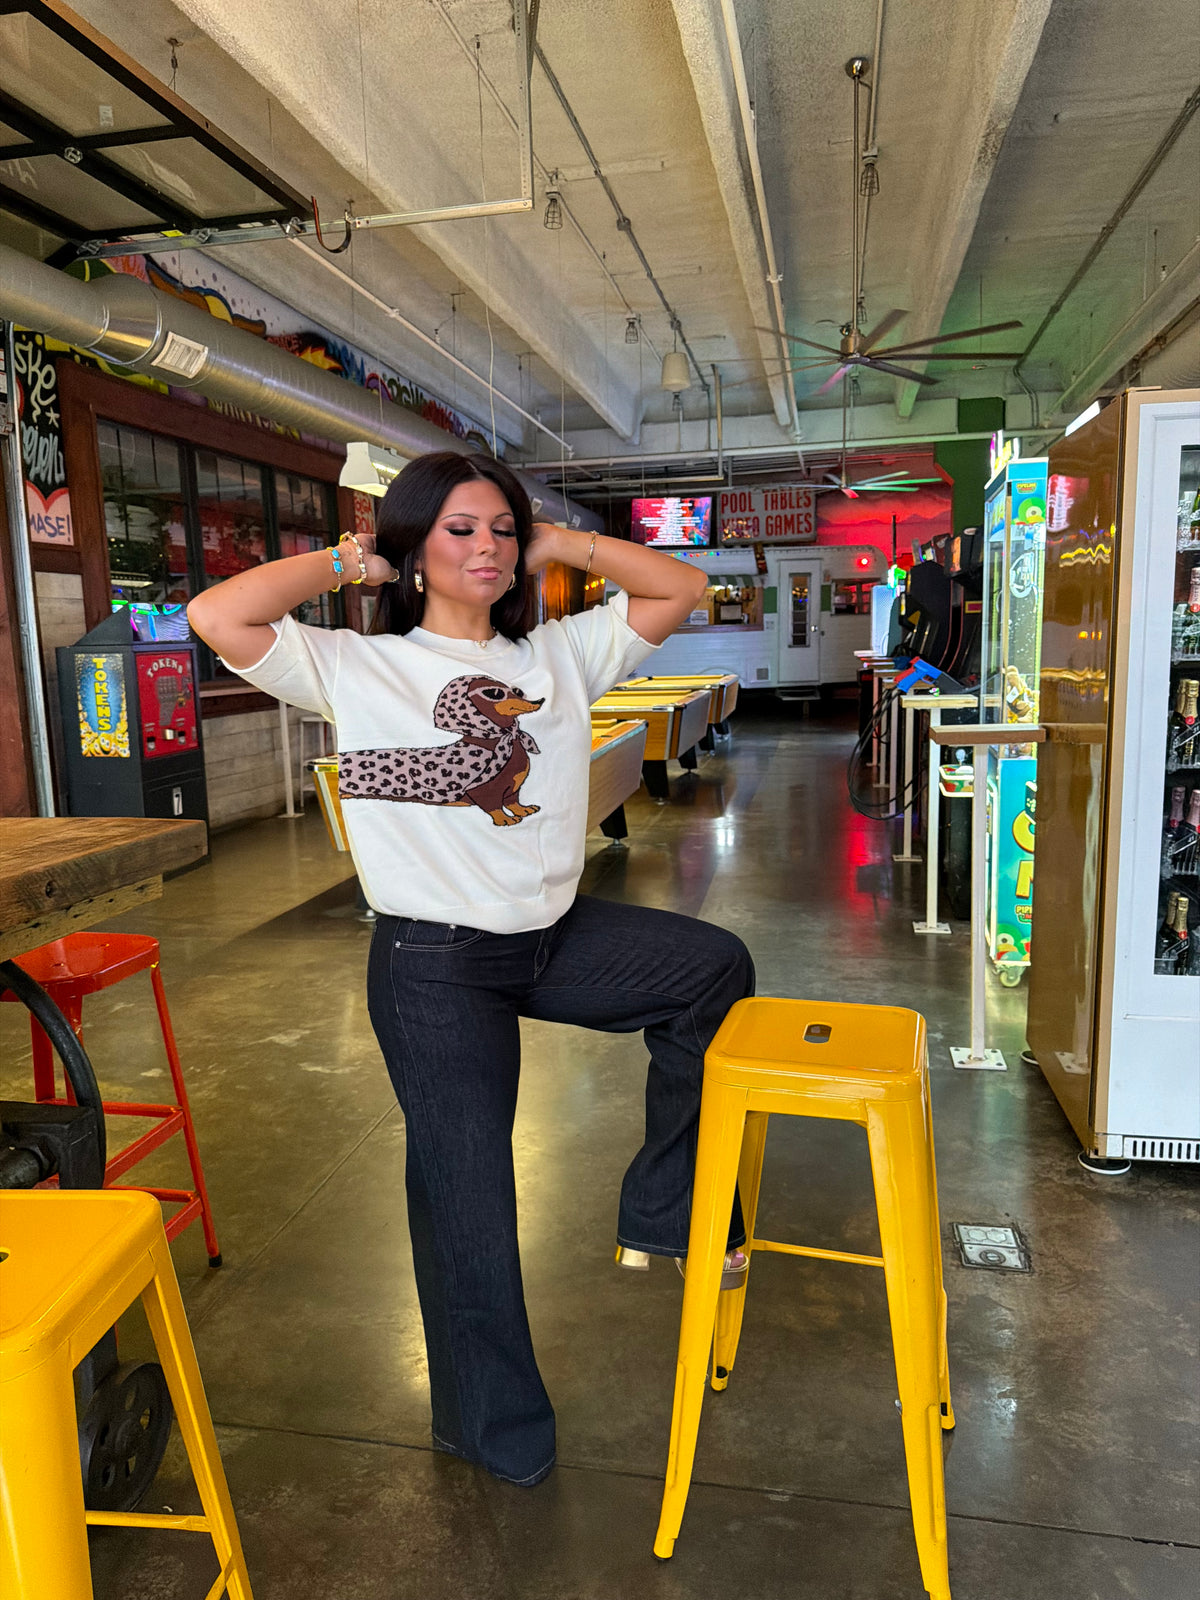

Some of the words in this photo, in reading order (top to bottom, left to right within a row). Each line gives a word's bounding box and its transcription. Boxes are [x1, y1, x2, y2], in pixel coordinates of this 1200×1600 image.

[721, 491, 755, 514] POOL
[763, 487, 812, 511] TABLES
[765, 512, 812, 537] GAMES
[146, 657, 184, 678] TOKENS
[92, 657, 112, 731] TOKENS
